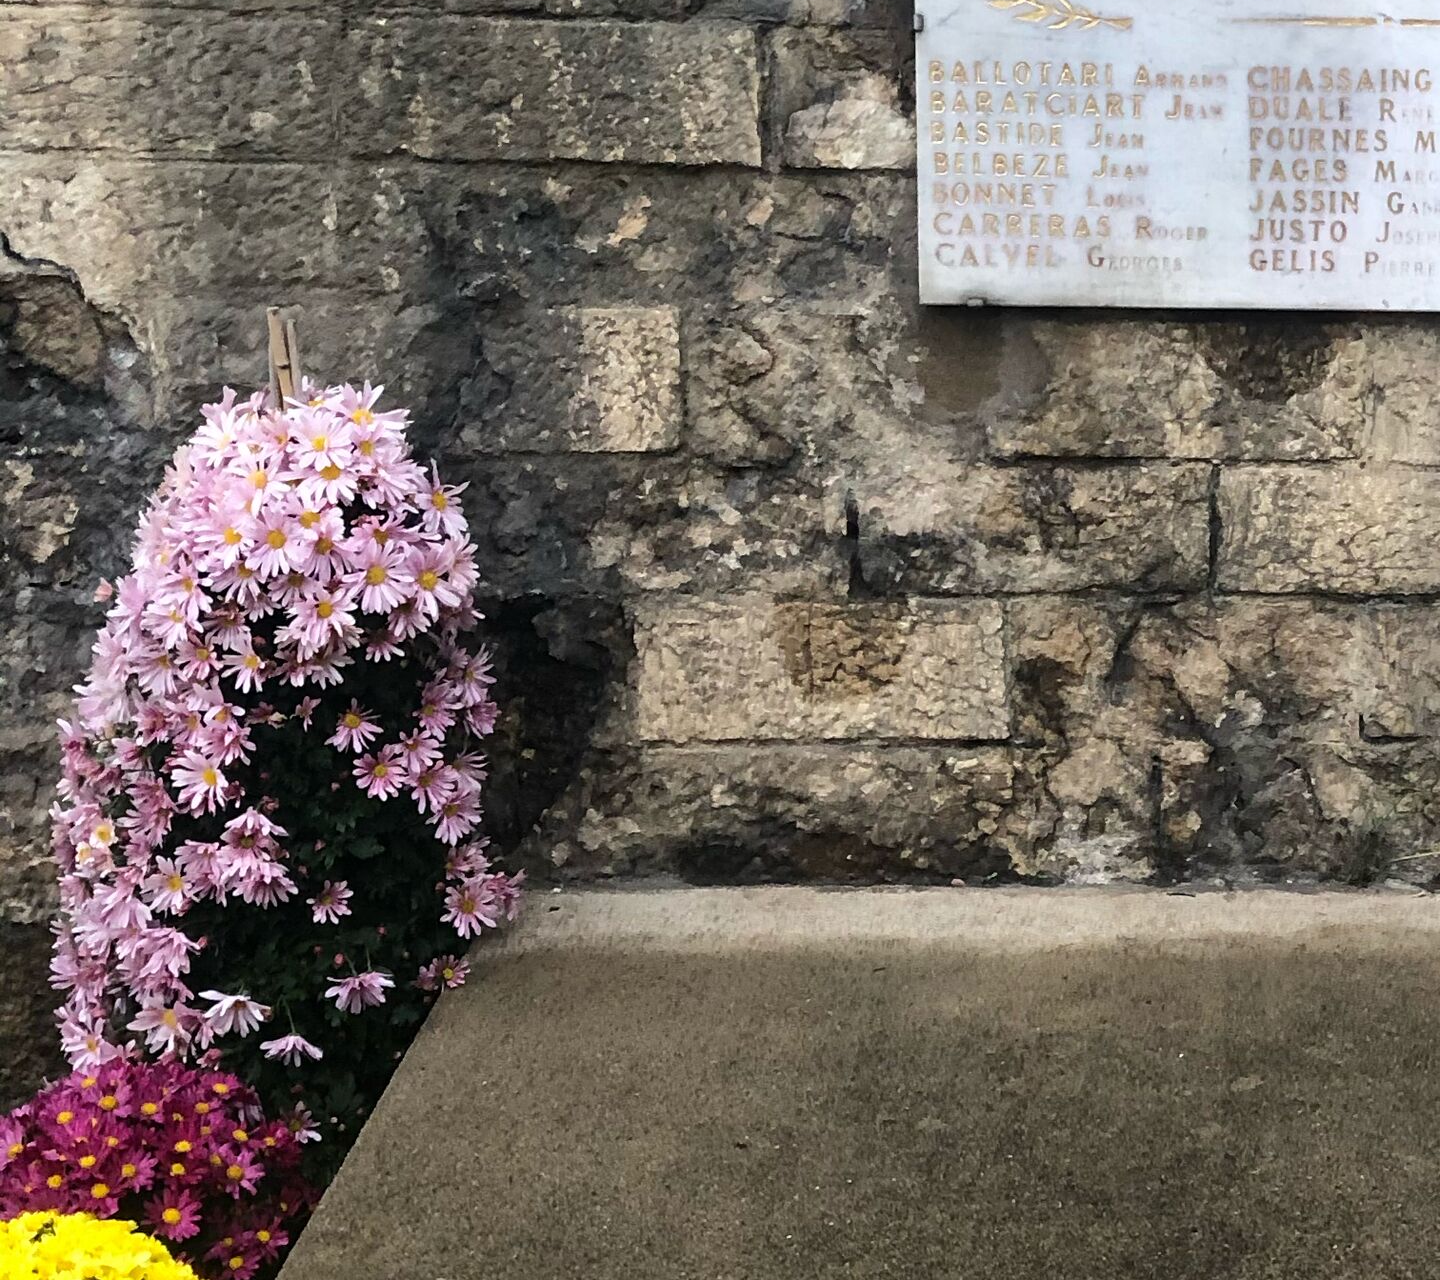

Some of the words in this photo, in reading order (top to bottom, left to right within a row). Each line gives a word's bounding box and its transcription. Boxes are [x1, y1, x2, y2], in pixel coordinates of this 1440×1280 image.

[928, 60, 1114, 87] BALLOTARI
[1247, 66, 1432, 93] CHASSAING
[929, 91, 1146, 118] BARATCIART
[1249, 96, 1352, 122] DUALE
[930, 121, 1063, 147] BASTIDE
[1249, 127, 1389, 153] FOURNES
[934, 152, 1069, 178] BELBEZE
[1249, 158, 1349, 183] FAGES
[932, 183, 1057, 208] BONNET
[1249, 190, 1359, 214] JASSIN
[933, 213, 1112, 239] CARRERAS
[1250, 219, 1348, 243] JUSTO
[934, 243, 1060, 268] CALVEL
[1249, 249, 1335, 272] GELIS
